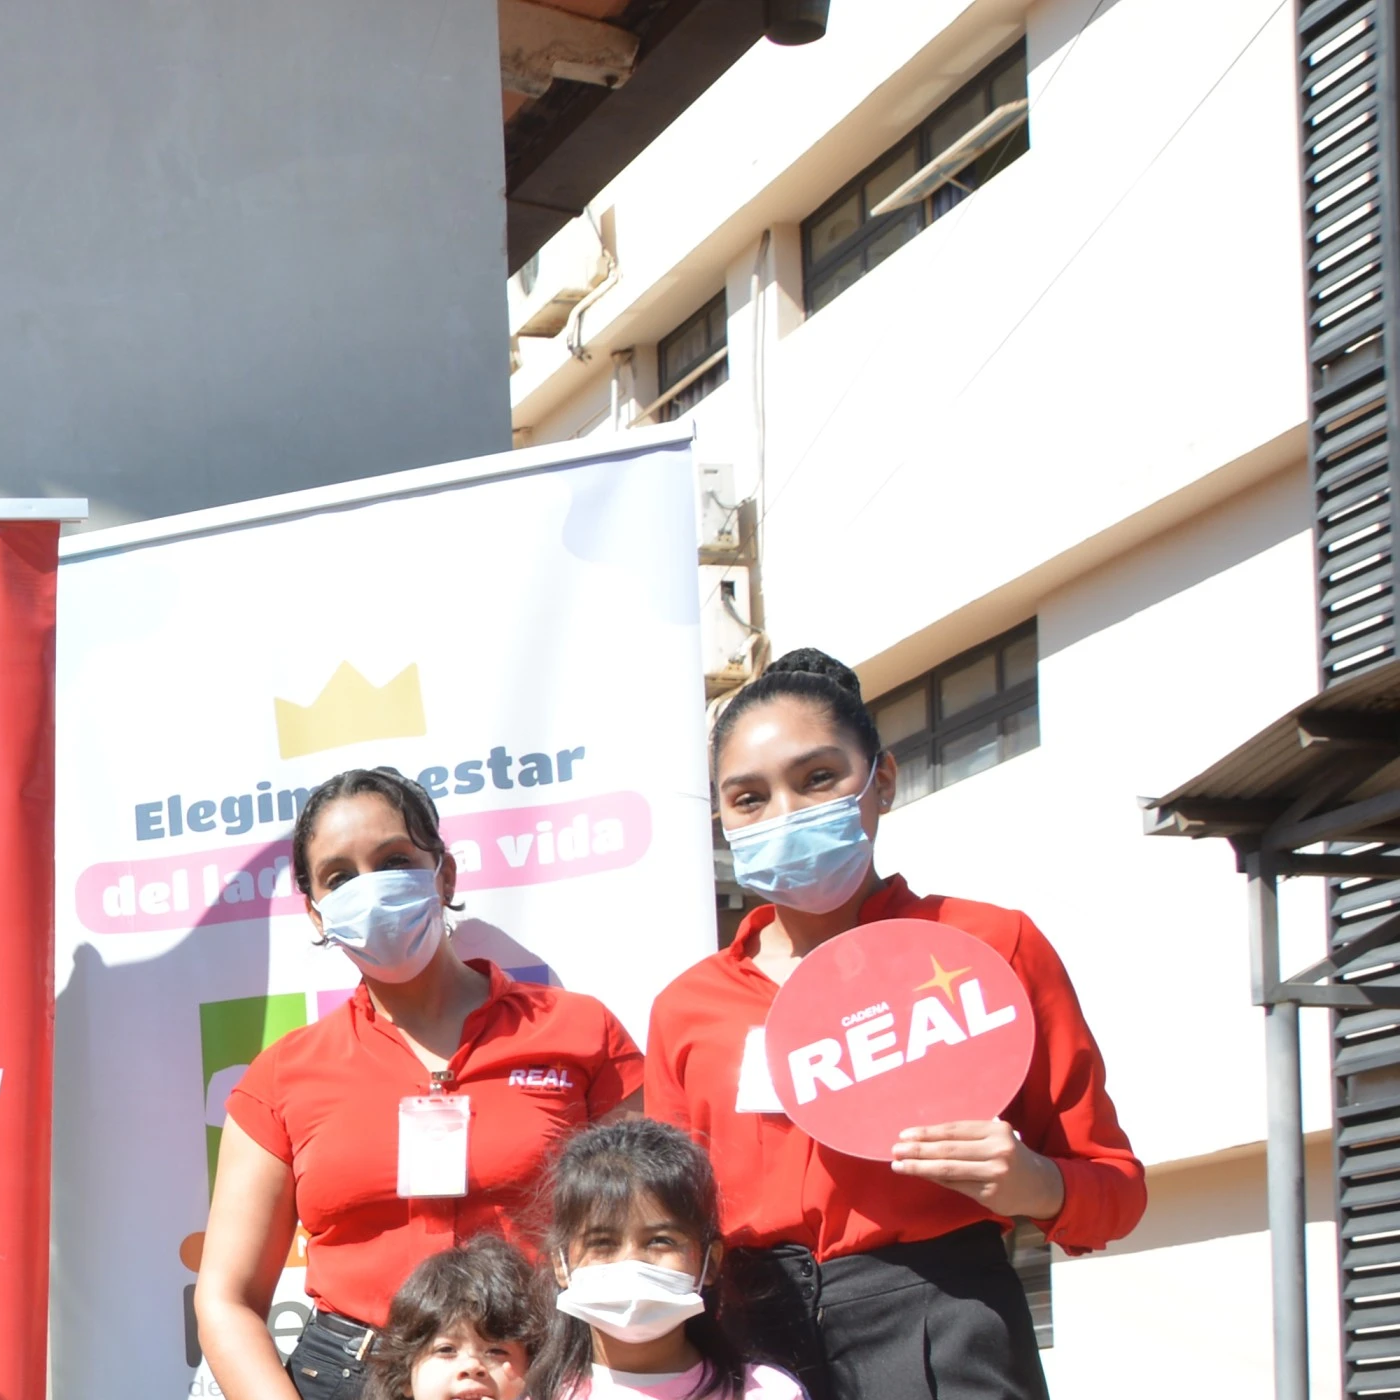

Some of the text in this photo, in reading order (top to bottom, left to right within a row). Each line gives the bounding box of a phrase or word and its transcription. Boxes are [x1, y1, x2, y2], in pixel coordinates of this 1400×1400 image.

[102, 868, 190, 917] del
[203, 856, 293, 907] lad
[496, 813, 624, 868] vida
[787, 977, 1016, 1105] REAL
[840, 1001, 890, 1027] CADENA
[508, 1068, 574, 1088] REAL
